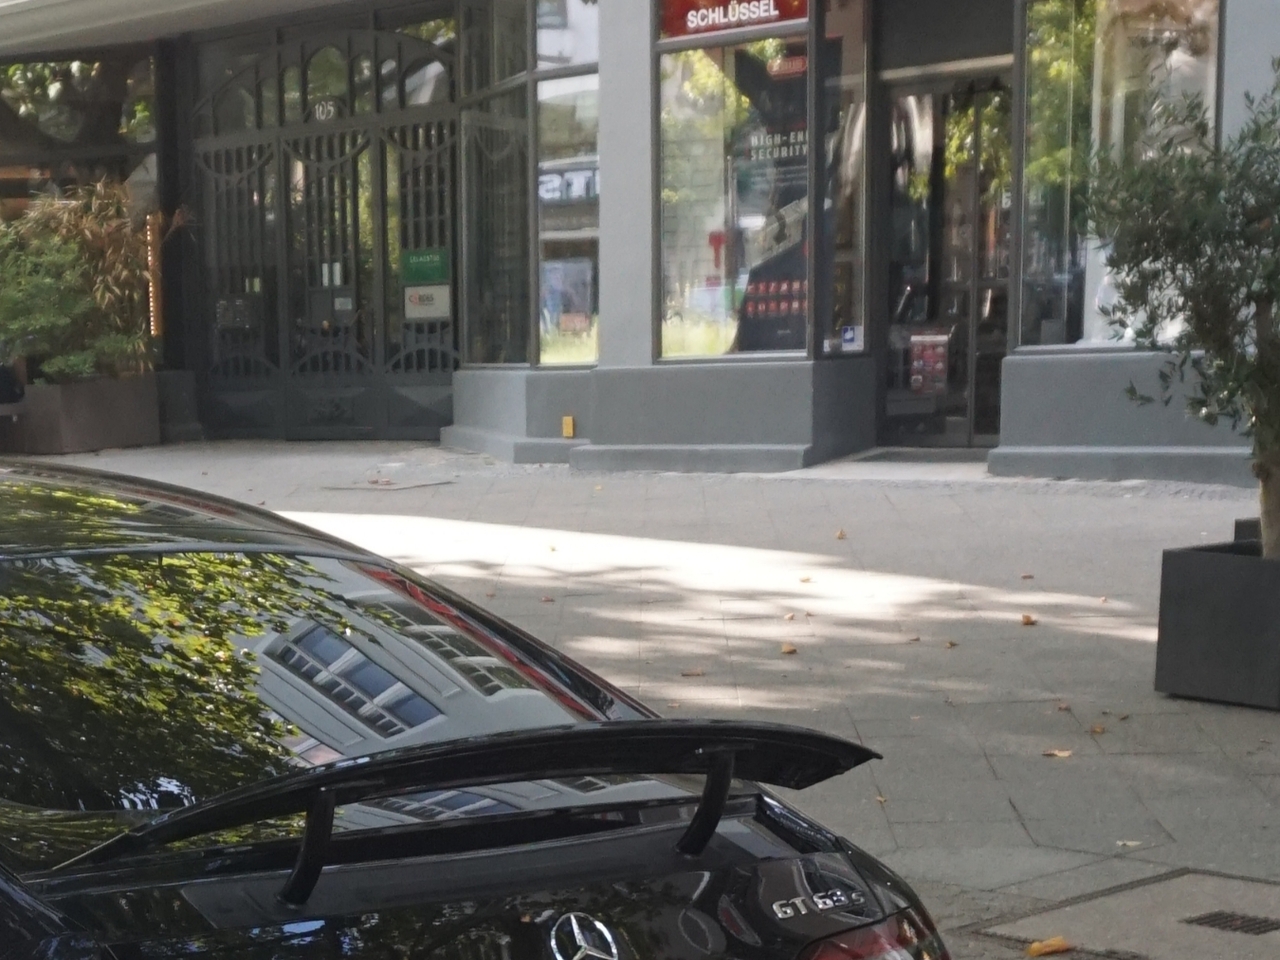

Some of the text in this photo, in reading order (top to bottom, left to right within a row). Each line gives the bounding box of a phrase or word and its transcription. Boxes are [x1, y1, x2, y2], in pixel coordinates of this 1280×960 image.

[687, 0, 779, 28] SCHLÜSSEL
[315, 101, 334, 120] 105
[772, 896, 808, 919] GT
[813, 888, 849, 910] 63
